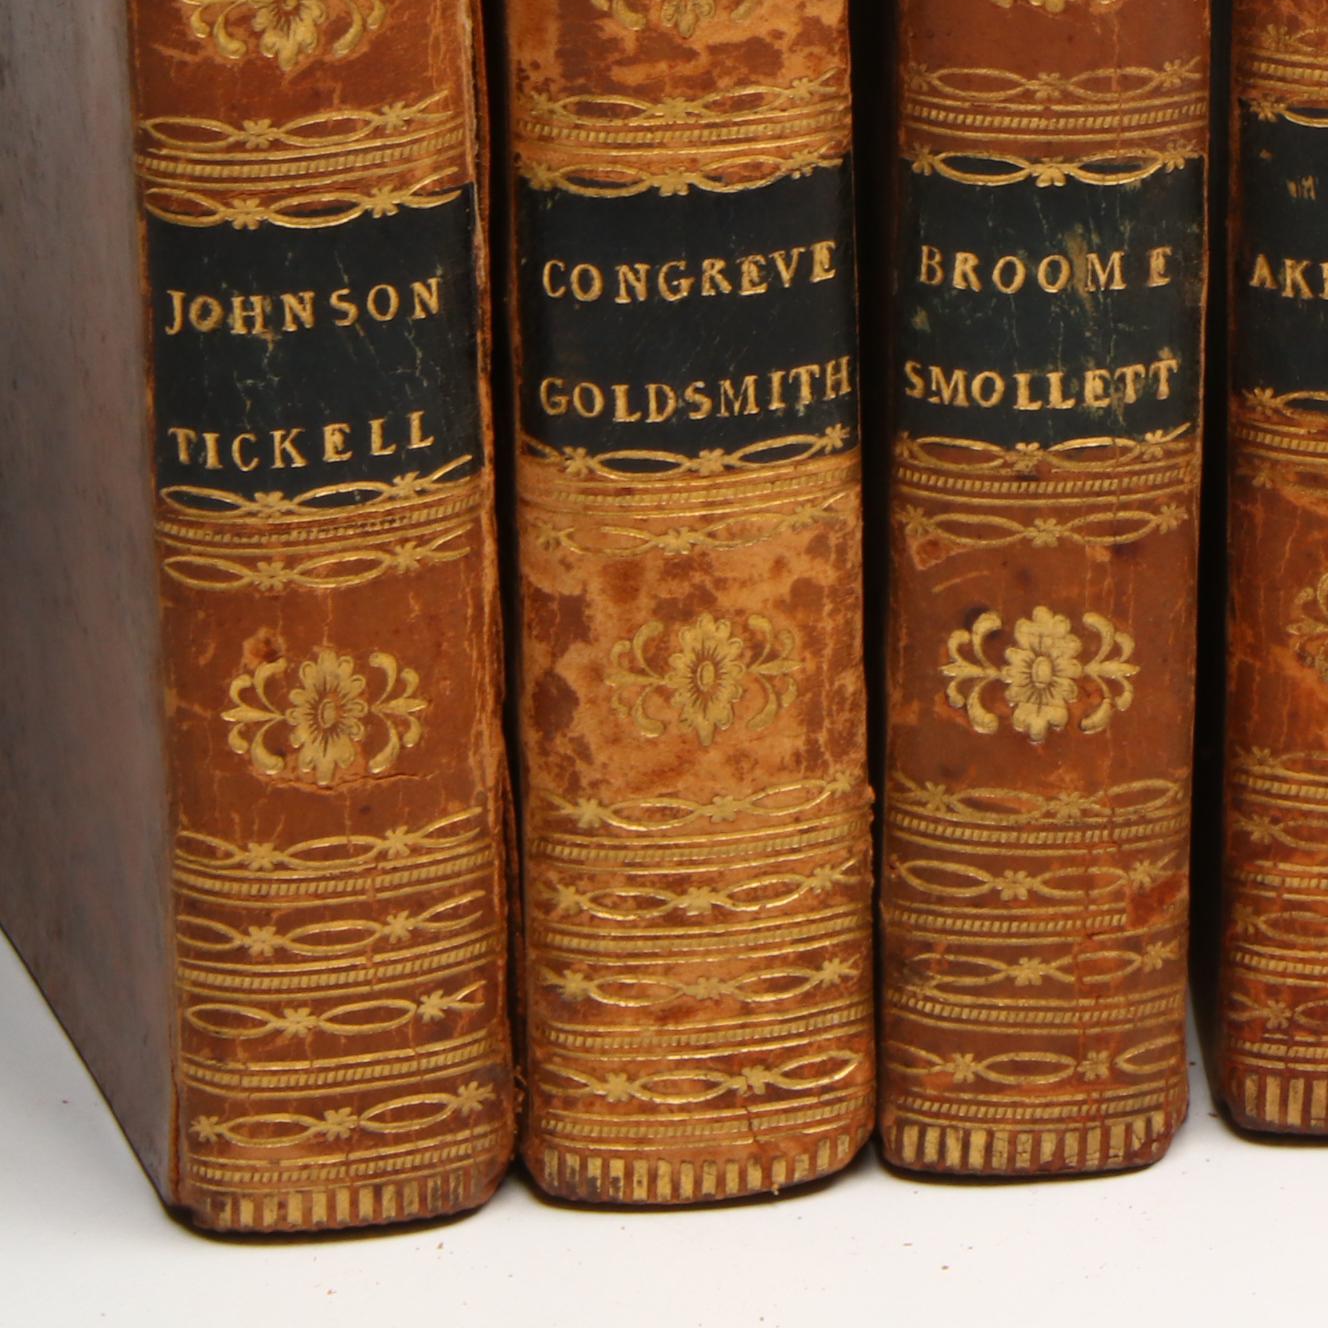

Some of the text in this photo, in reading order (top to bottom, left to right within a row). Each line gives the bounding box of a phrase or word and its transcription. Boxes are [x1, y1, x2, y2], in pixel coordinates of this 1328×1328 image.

[541, 240, 838, 305] CONGREVE
[919, 244, 1174, 294] BROOME
[166, 277, 444, 336] JOHNSON
[539, 355, 852, 424] GOLDSMITH
[904, 356, 1179, 411] SMOLLETT
[168, 410, 434, 472] TICKELL
